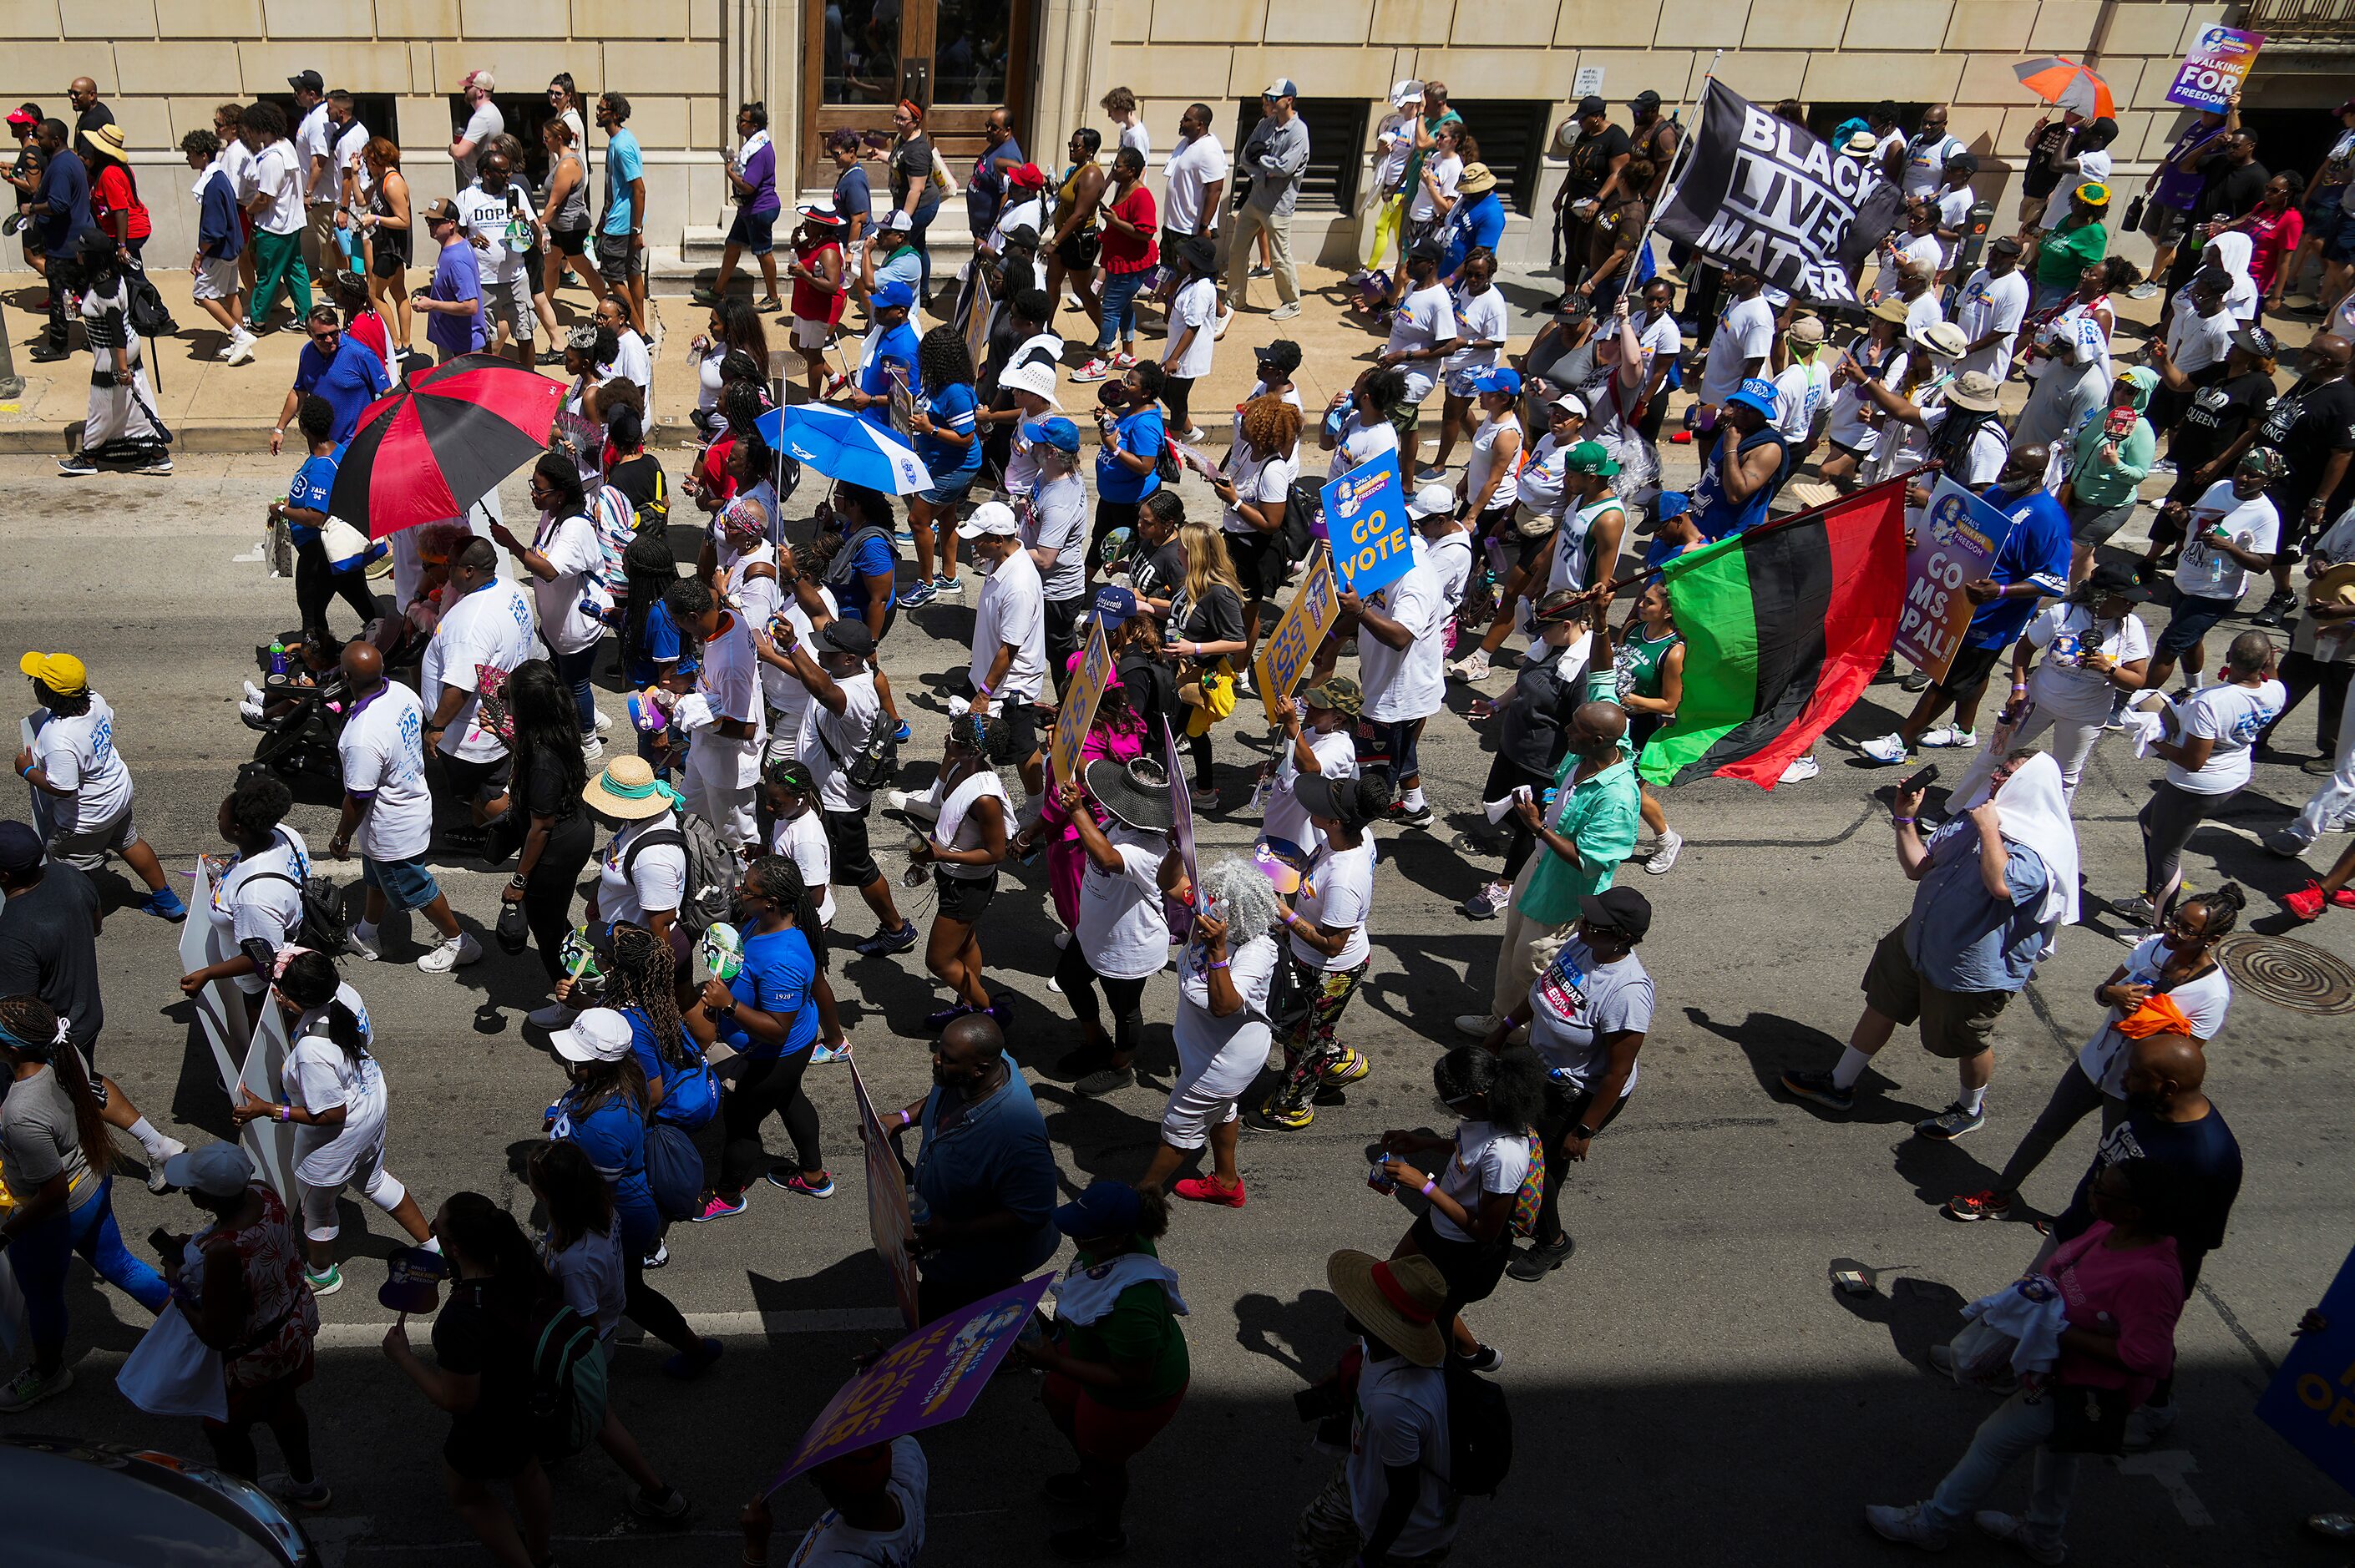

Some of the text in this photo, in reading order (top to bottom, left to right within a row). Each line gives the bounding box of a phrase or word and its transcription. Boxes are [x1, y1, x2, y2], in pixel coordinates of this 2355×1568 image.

[2191, 55, 2245, 75] WALKING
[2221, 45, 2245, 54] FREEDOM
[2180, 66, 2238, 96] FOR
[1740, 104, 1882, 208] BLACK
[2186, 407, 2221, 428] QUEEN
[311, 487, 326, 495] FALL
[1354, 473, 1372, 488] OPAL'S
[1358, 481, 1386, 503] FREEDOM
[1351, 509, 1386, 544] GO
[1957, 522, 1987, 546] WALK FOR
[1961, 513, 1981, 531] OPAL'S
[1340, 526, 1407, 581] VOTE
[1952, 531, 1984, 558] FREEDOM
[1927, 551, 1963, 590] GO
[1907, 576, 1949, 625] MS.
[1286, 605, 1309, 667] VOTE
[1898, 604, 1957, 665] PAL!
[1271, 626, 1296, 691] FOR
[1073, 685, 1086, 726] GO
[1060, 701, 1079, 774] VOTE
[966, 1337, 995, 1373] OPAL'S
[823, 1337, 924, 1450] FOR
[856, 1322, 954, 1438] WALKING
[920, 1351, 966, 1406] FREEDOM
[2297, 1372, 2355, 1428] OP
